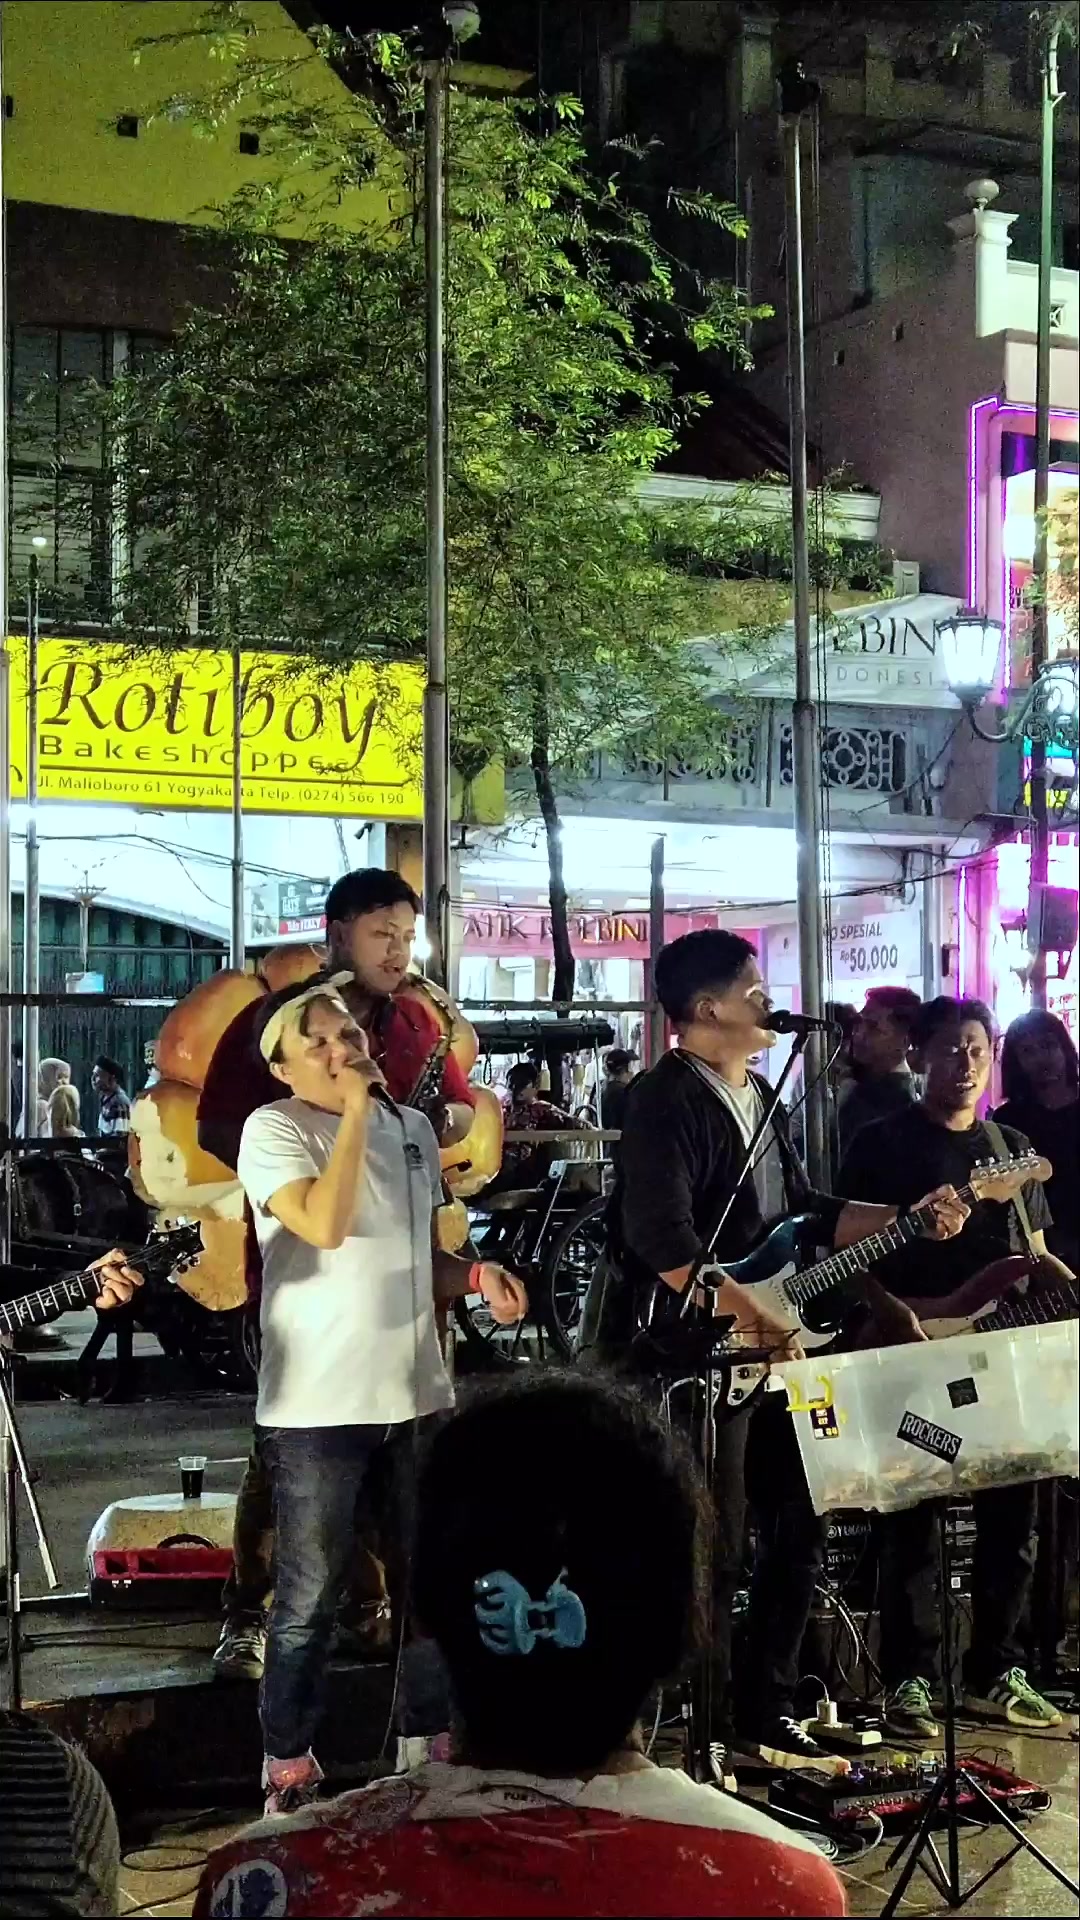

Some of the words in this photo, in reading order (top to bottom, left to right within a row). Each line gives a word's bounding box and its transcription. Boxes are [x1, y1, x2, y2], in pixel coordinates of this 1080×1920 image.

[40, 661, 378, 772] Rotiboy
[40, 734, 326, 774] Bakeshoppe
[38, 775, 53, 788] Jl.
[59, 776, 139, 792] Malioboro
[144, 780, 161, 793] 61
[168, 782, 254, 798] Yogyakata
[260, 787, 295, 803] Telp.
[299, 788, 344, 804] (0274)
[349, 791, 374, 803] 566
[380, 792, 404, 804] 190
[840, 922, 882, 940] SPESIAL
[902, 1415, 959, 1454] ROCKERS
